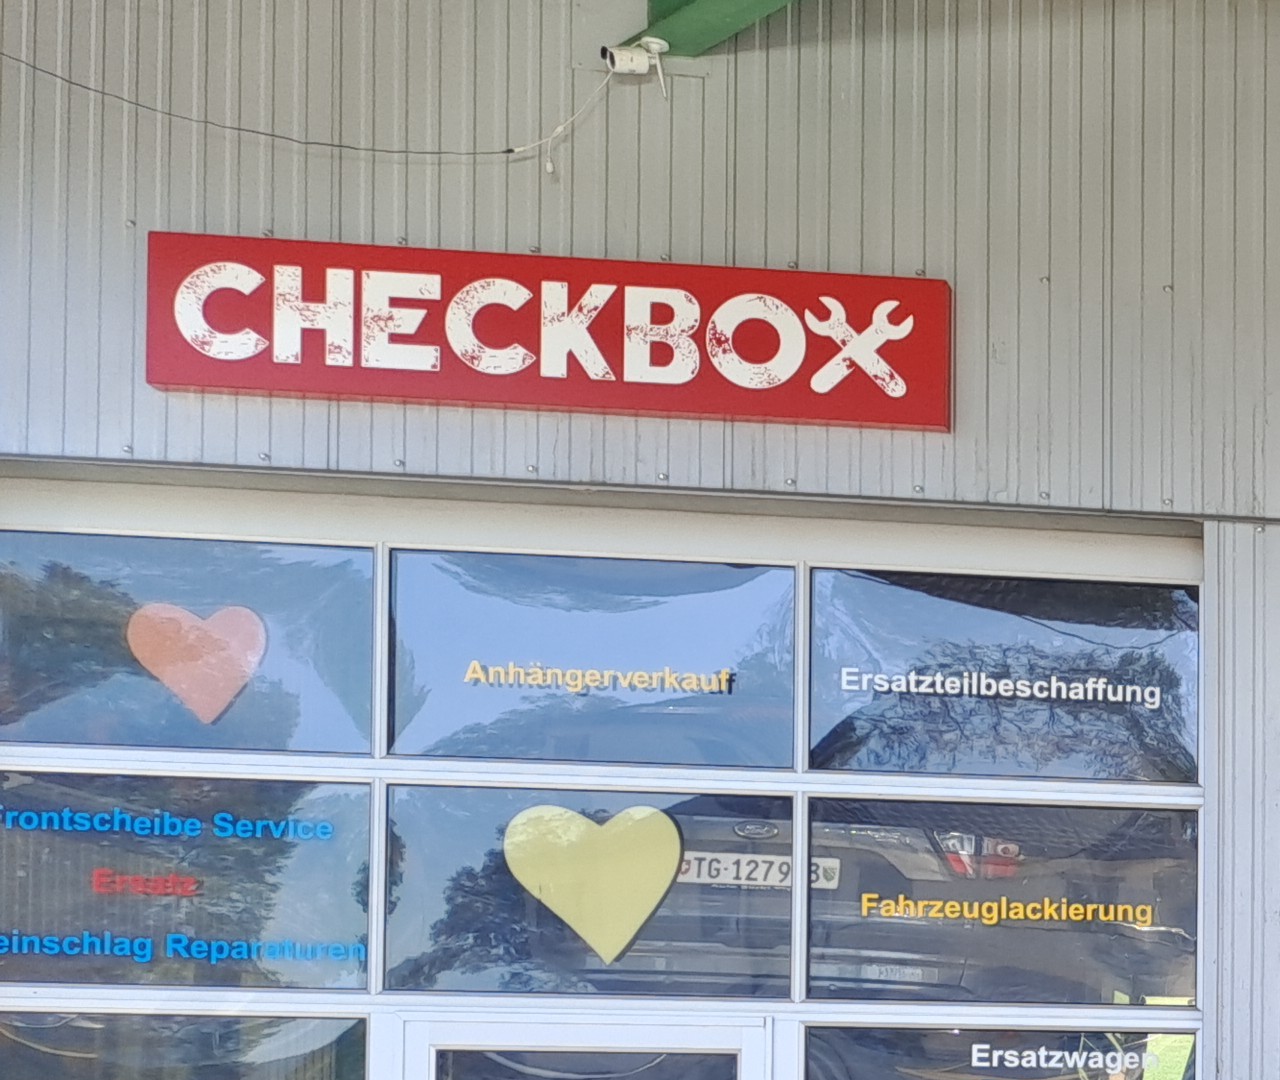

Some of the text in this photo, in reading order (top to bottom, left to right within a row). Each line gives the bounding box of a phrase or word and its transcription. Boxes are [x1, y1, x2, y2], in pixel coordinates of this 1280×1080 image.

[463, 658, 735, 695] Anhängerverkauf
[840, 667, 1162, 709] Ersatzteilbeschaffung
[0, 805, 334, 841] rontscheibe Service
[91, 867, 203, 897] Ersatz
[860, 893, 1153, 927] Fahrzeuglackierung
[166, 932, 367, 964] Reparaturen
[970, 1043, 1160, 1074] Ersatzwagen
